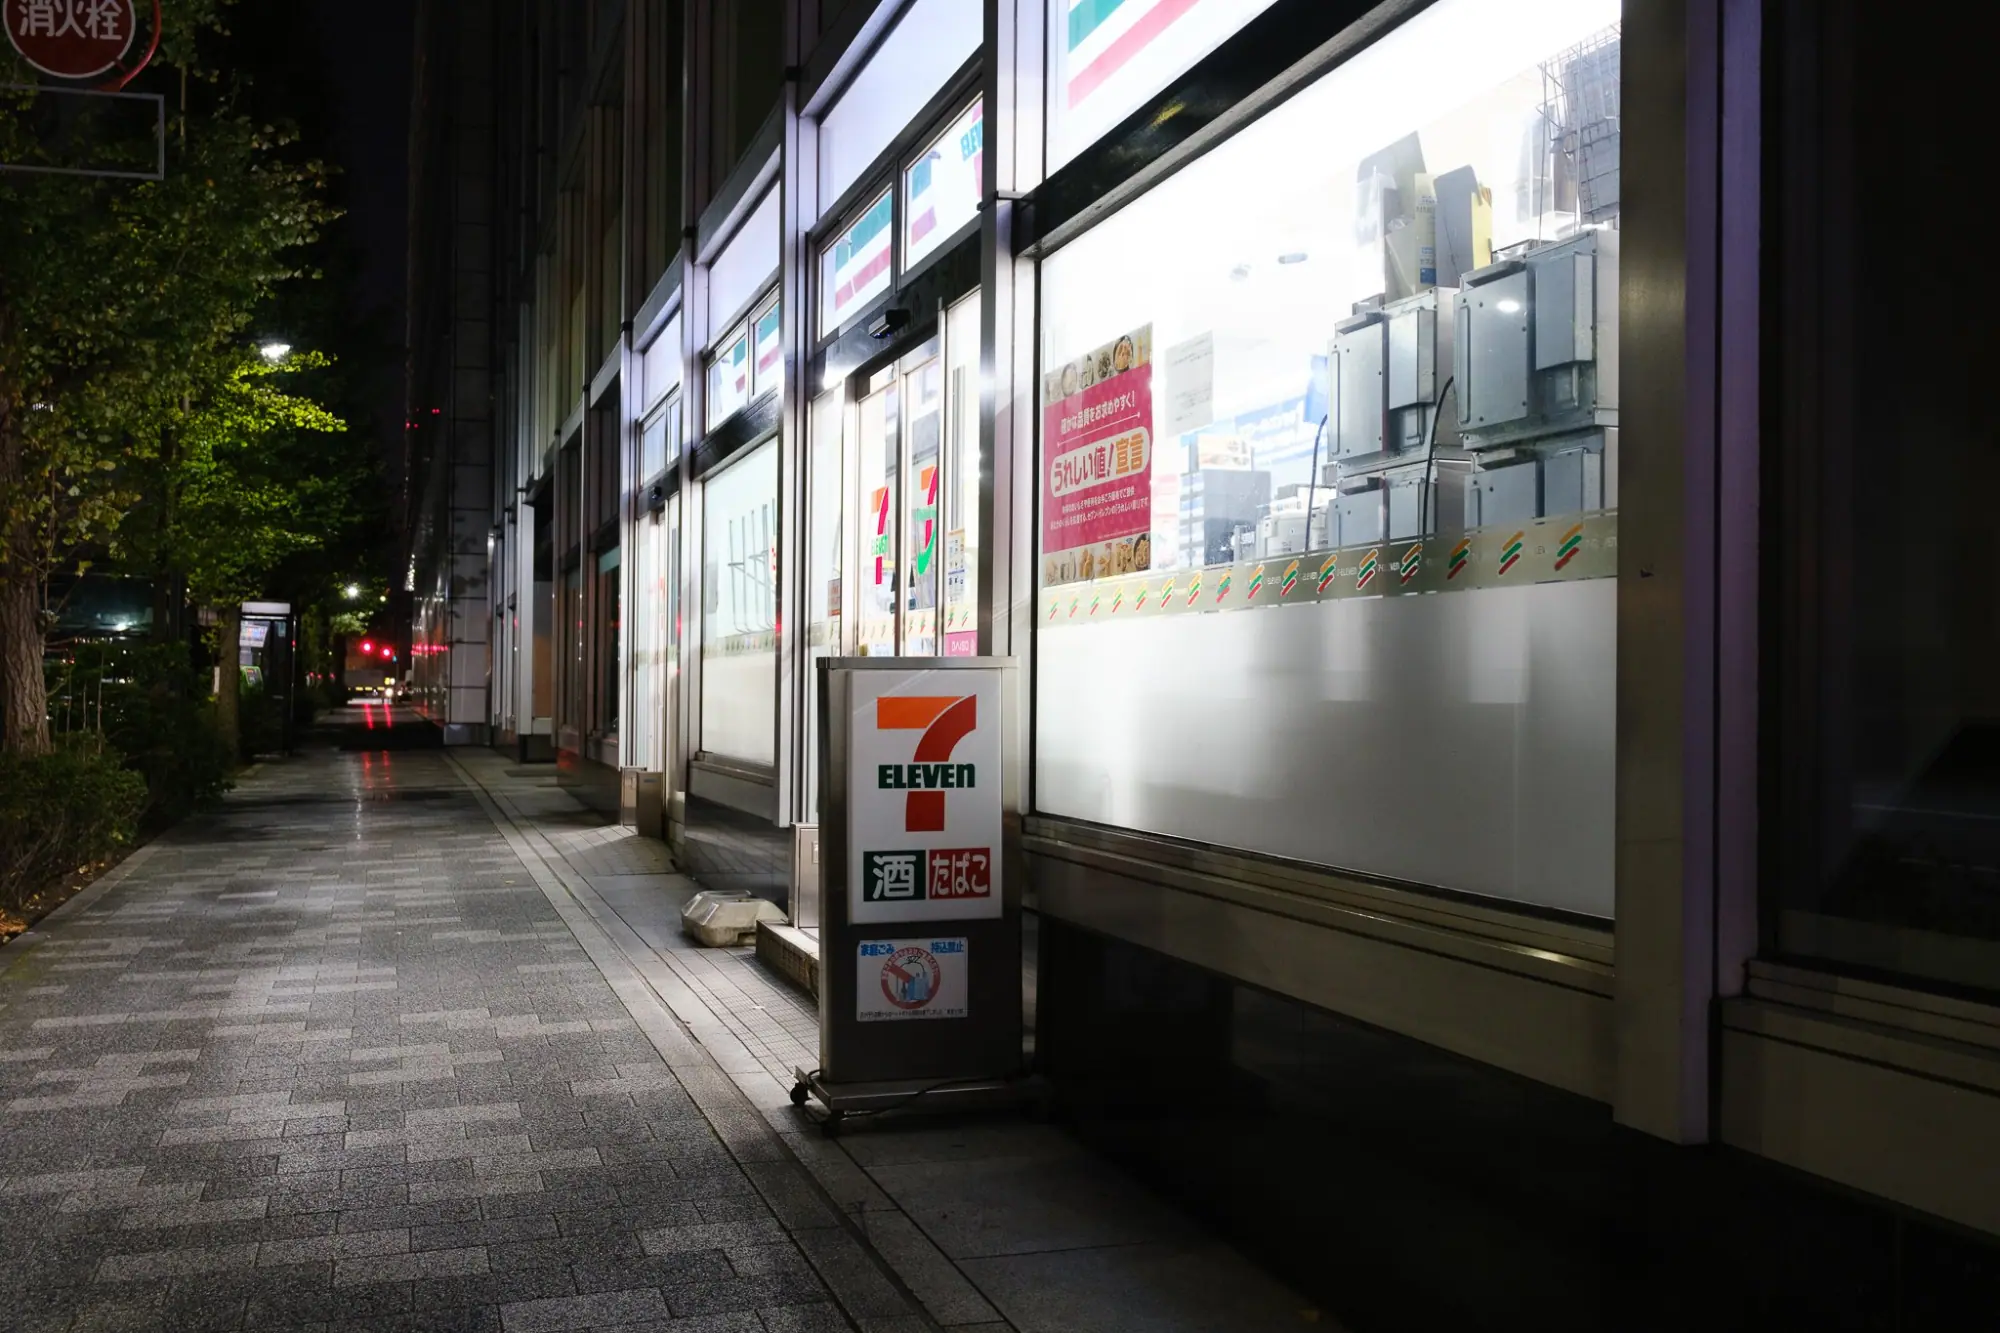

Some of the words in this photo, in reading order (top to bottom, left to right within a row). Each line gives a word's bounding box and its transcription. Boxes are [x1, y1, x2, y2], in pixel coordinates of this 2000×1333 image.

[17, 0, 123, 40] 消火栓
[951, 640, 970, 652] DAISO
[872, 854, 917, 900] 酒
[931, 852, 990, 898] たばこ
[860, 943, 896, 957] 家庭ごみ
[930, 940, 964, 954] 持込禁止
